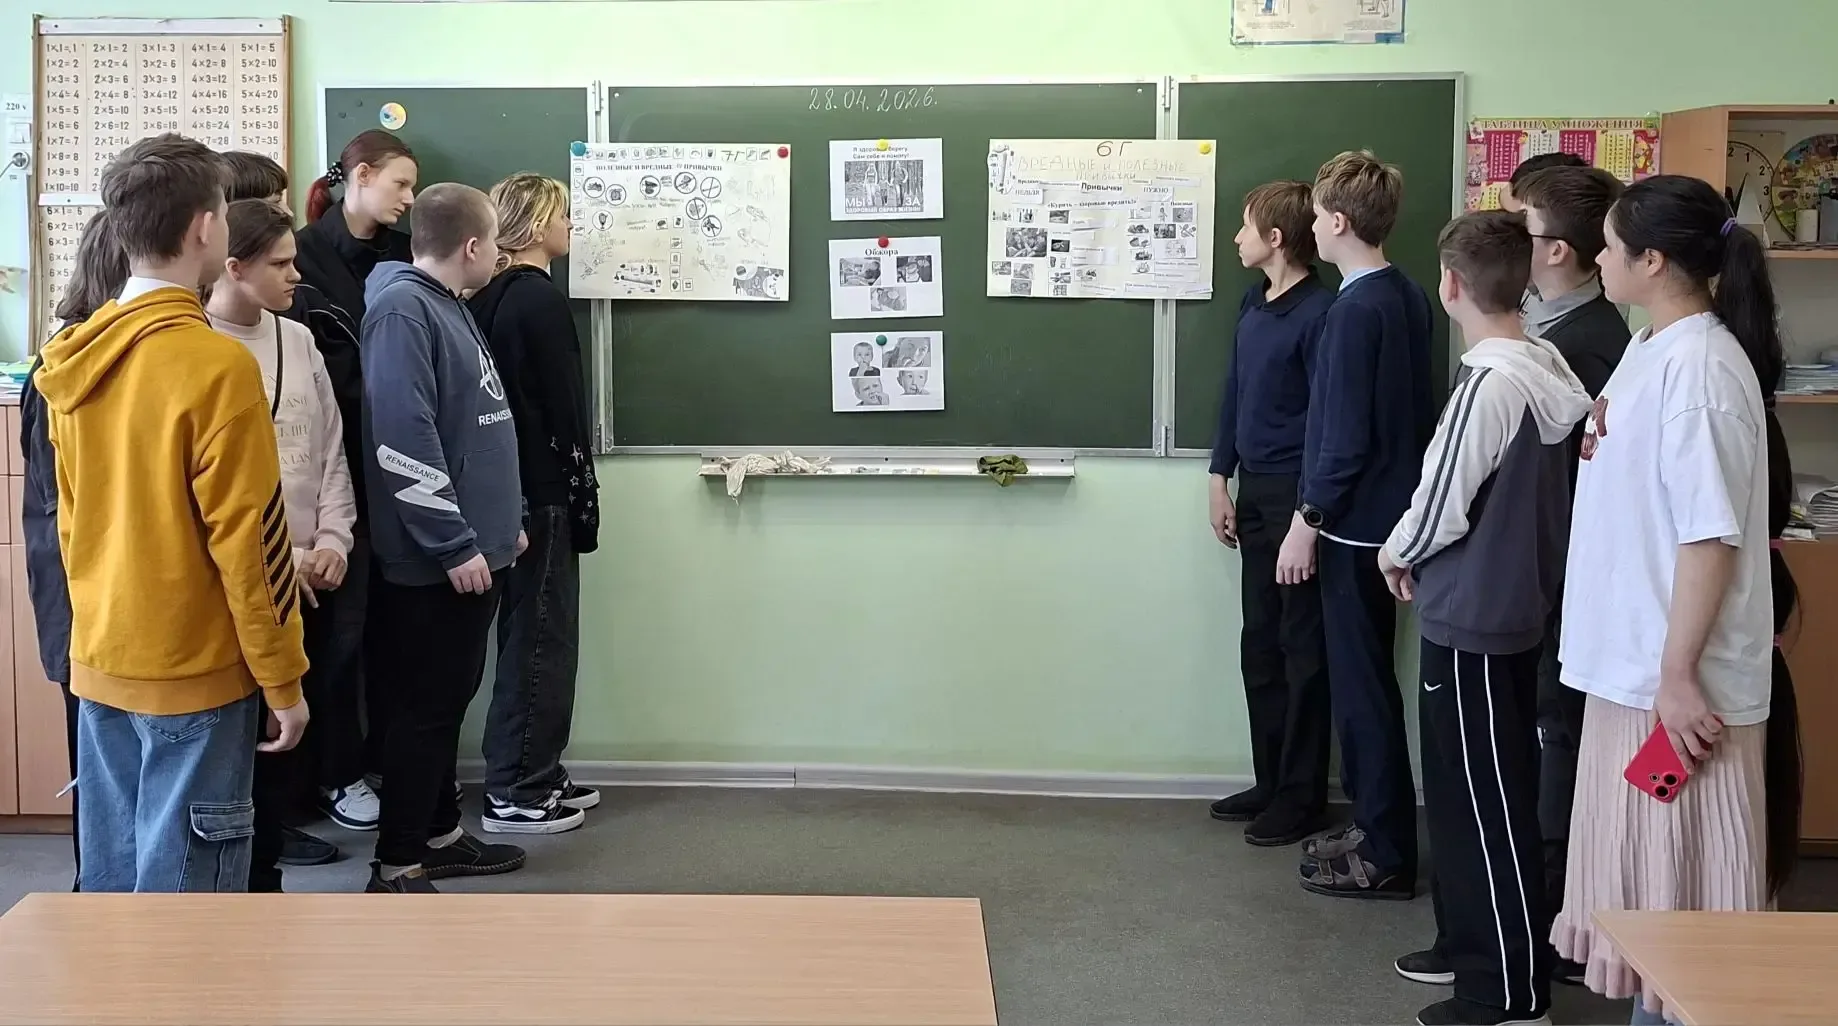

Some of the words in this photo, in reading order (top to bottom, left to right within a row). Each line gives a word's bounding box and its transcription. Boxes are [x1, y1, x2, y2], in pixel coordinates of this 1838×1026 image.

[6, 102, 20, 110] 220
[1484, 119, 1547, 129] ТАБЛИЦА
[1551, 119, 1643, 129] УМНОЖЕНИЯ
[1760, 167, 1765, 176] 2
[1081, 182, 1122, 192] Привычки
[1763, 186, 1769, 196] 3
[846, 198, 865, 207] МЫ
[905, 197, 920, 206] ЗА
[865, 248, 899, 256] Обжора
[385, 454, 440, 482] RENAISSANCE
